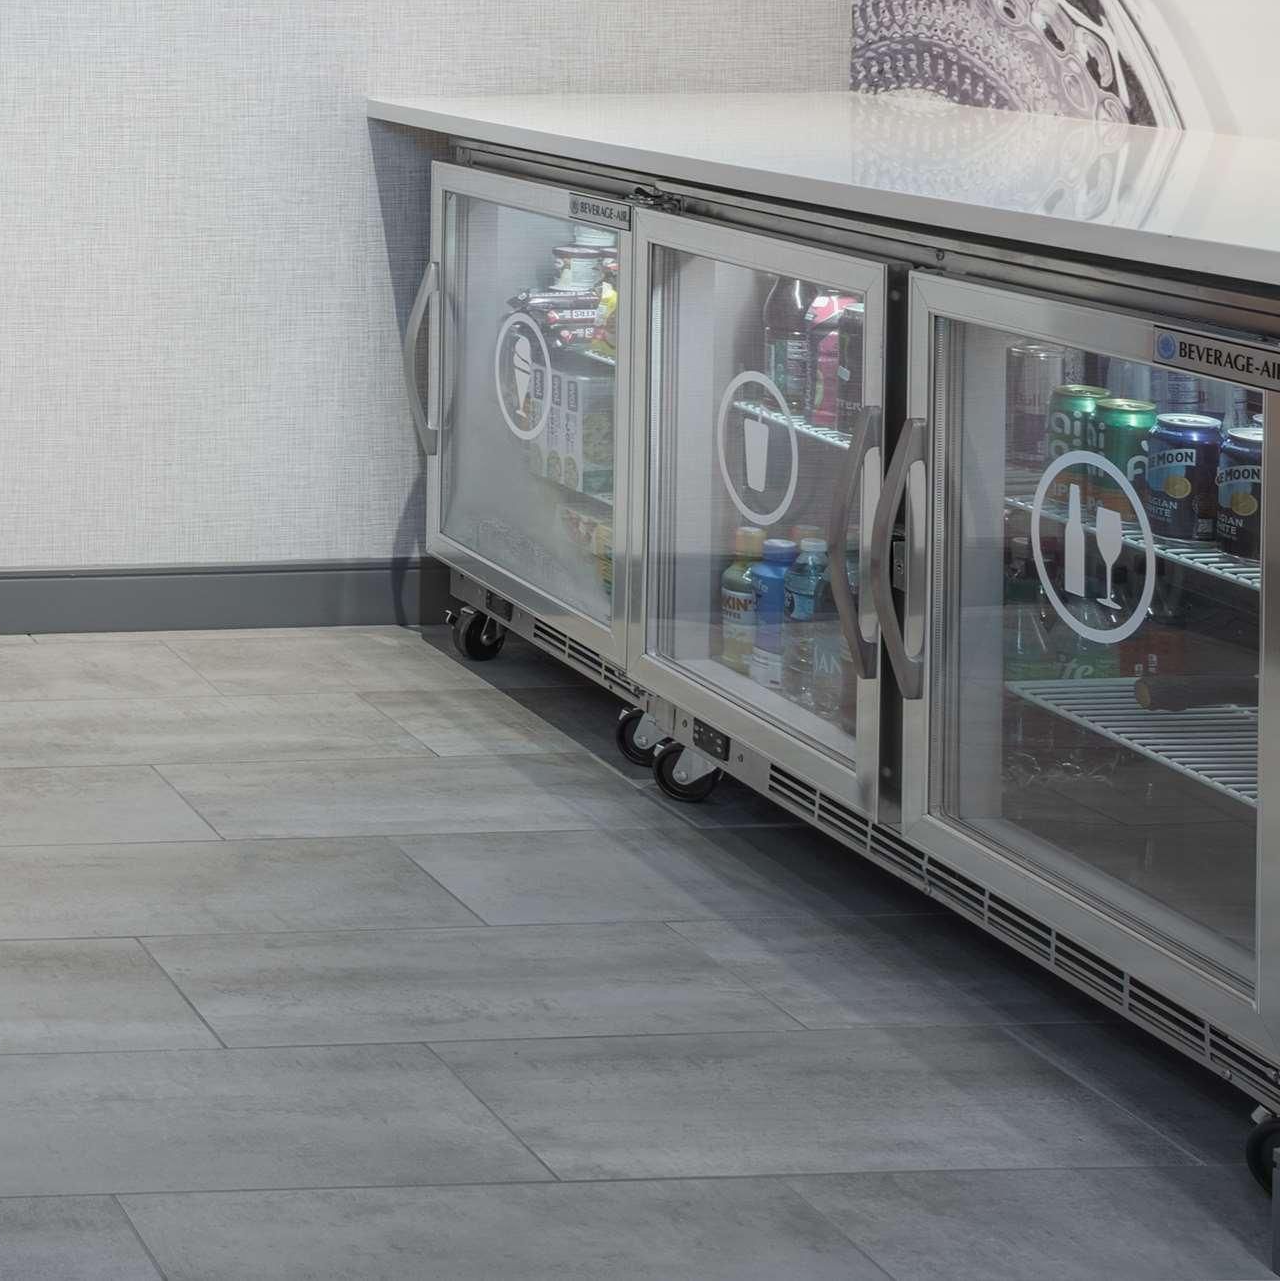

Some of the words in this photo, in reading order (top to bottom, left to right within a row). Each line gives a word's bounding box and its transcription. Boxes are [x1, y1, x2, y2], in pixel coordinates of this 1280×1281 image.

[579, 201, 630, 224] BEVERAGE-AIR
[1178, 340, 1280, 381] BEVERAGE-AI
[1157, 450, 1194, 467] MOON
[1225, 467, 1261, 483] MOON
